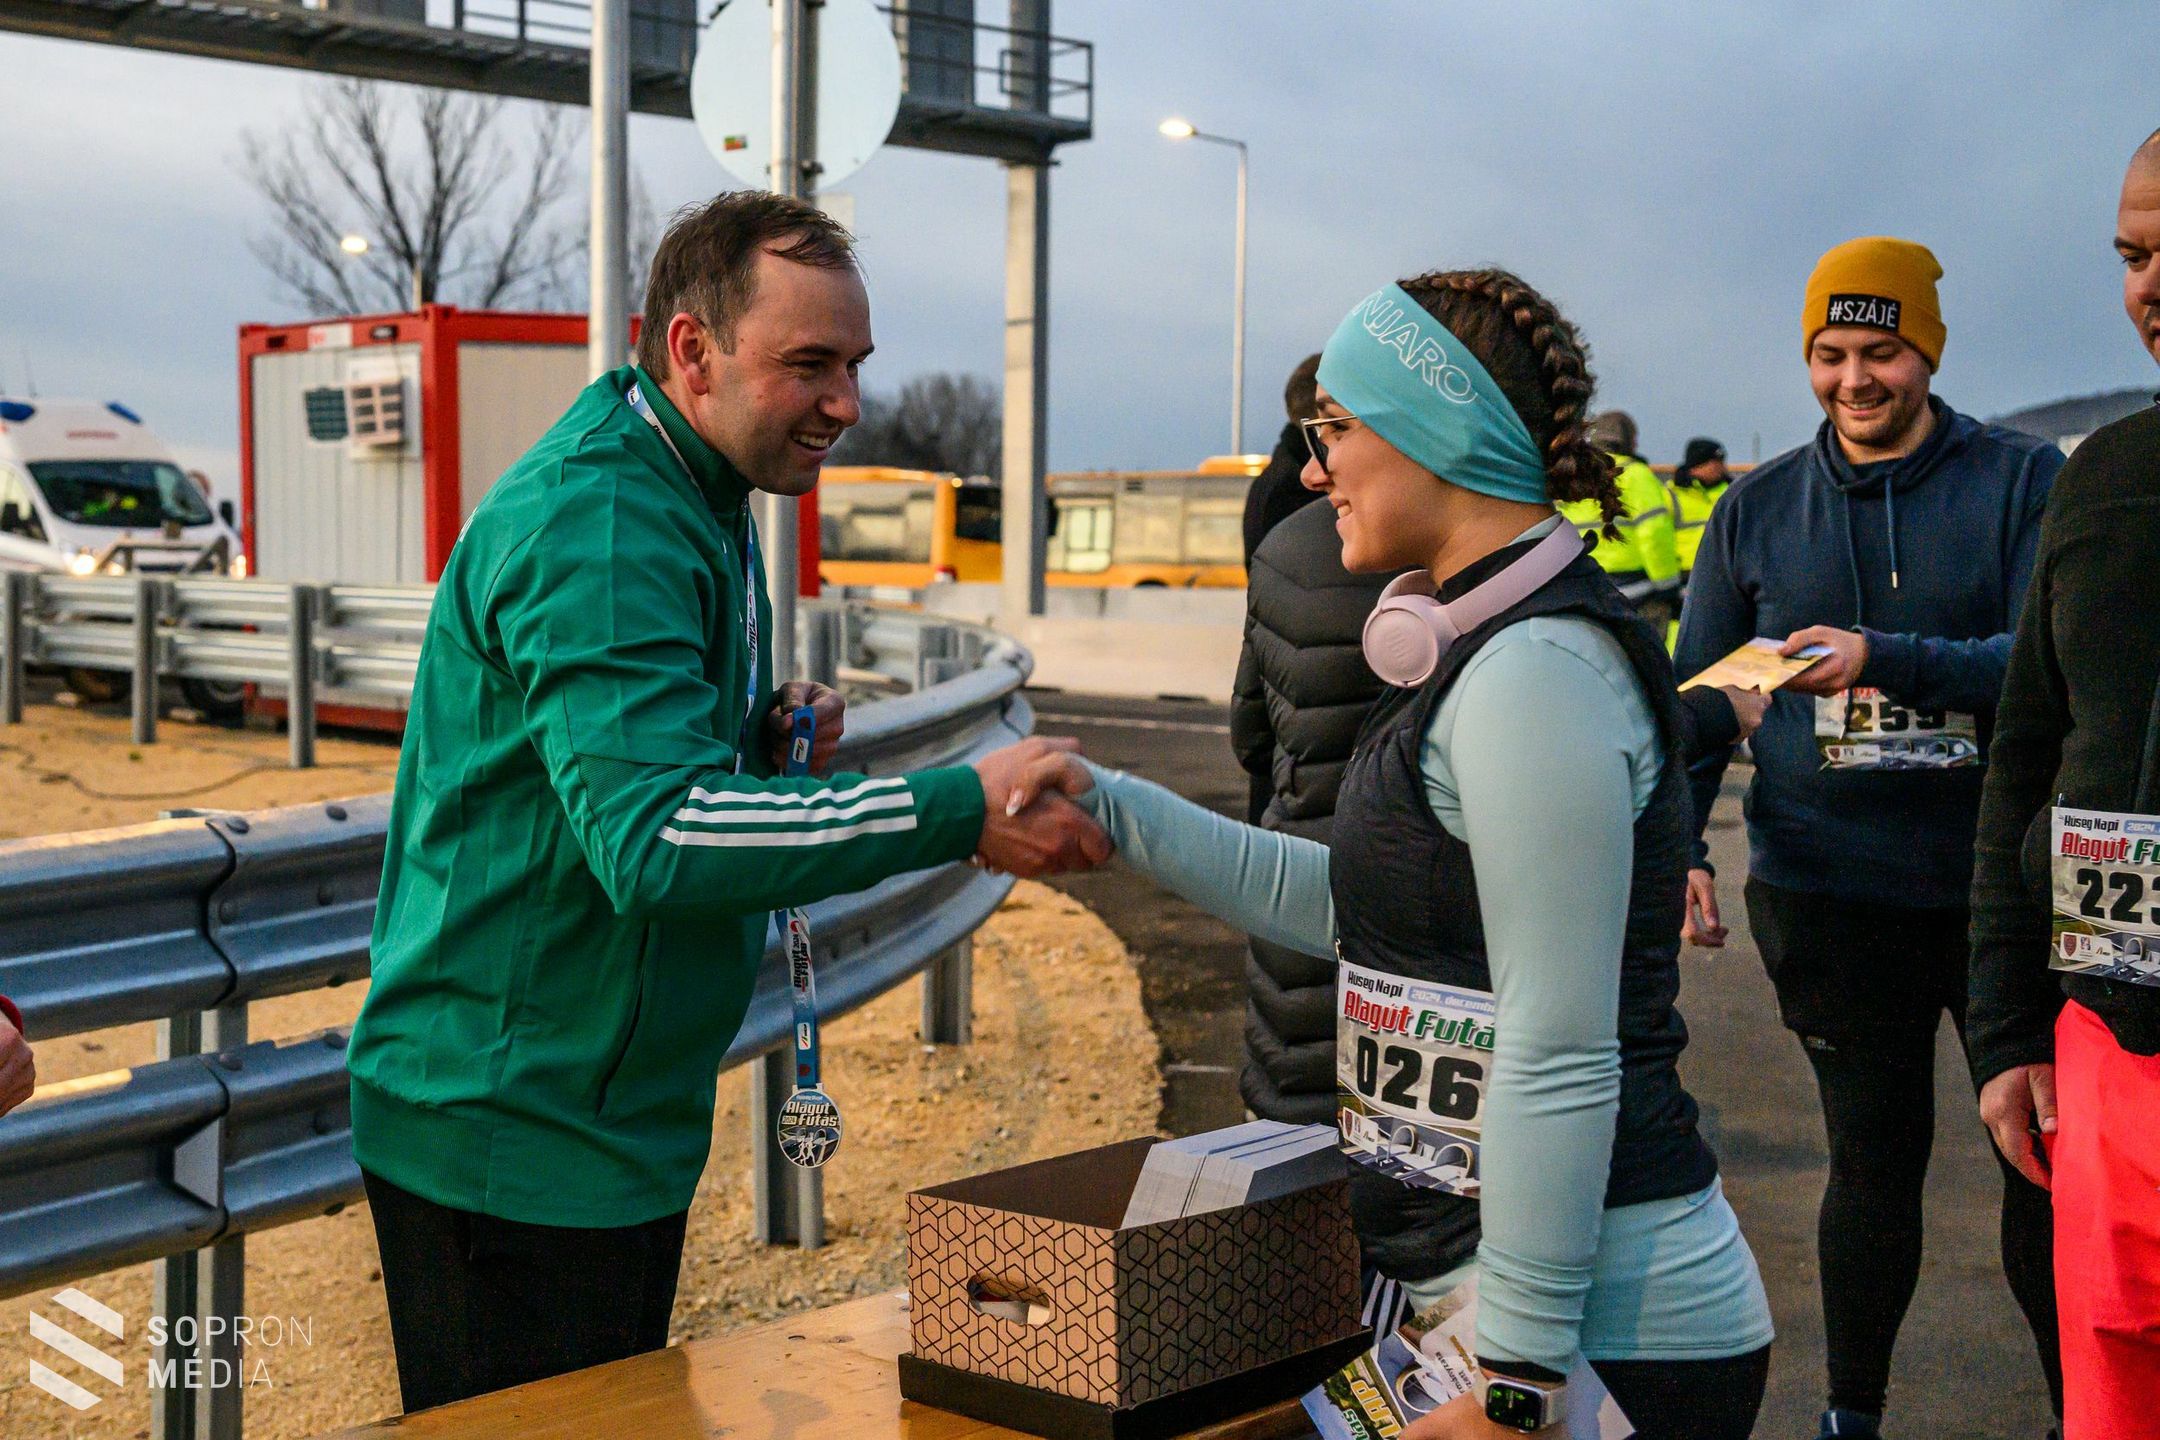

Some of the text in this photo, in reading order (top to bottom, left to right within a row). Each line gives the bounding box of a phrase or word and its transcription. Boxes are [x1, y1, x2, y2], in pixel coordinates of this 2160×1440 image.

[1829, 298, 1898, 328] #SZÁJÉ
[2094, 818, 2120, 834] Napi
[2076, 867, 2160, 926] 22
[1376, 978, 1405, 998] Napi
[1357, 1035, 1484, 1121] 026
[1350, 1379, 1403, 1440] LAP
